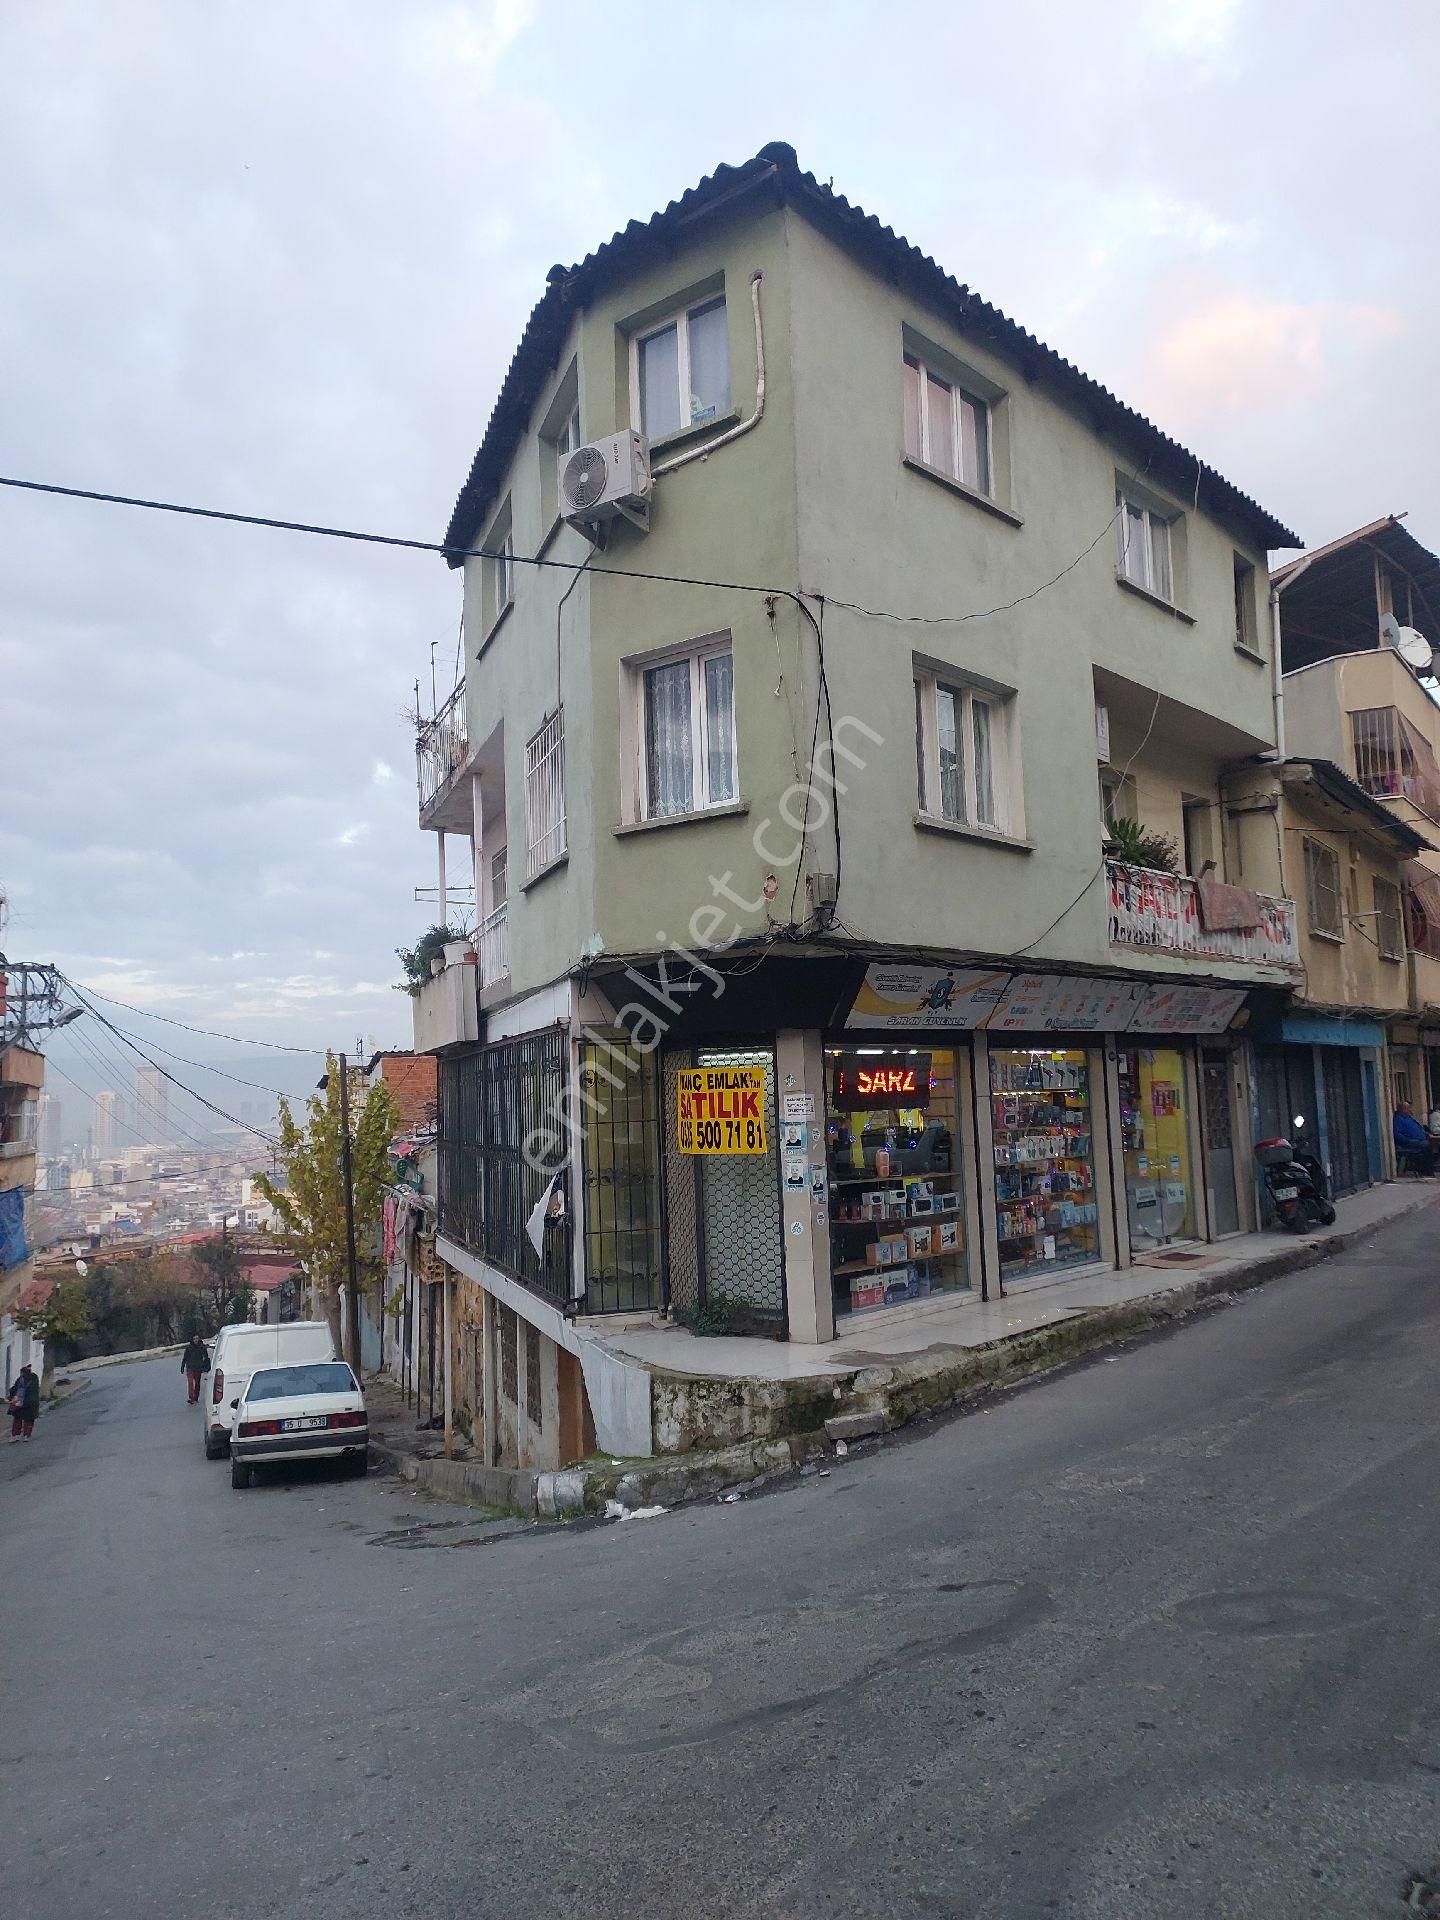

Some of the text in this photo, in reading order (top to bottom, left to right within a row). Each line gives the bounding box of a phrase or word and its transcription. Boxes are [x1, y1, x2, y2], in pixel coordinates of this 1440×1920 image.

[680, 1091, 760, 1120] SATILIK
[697, 1120, 722, 1149] 500
[725, 1120, 741, 1149] 71
[747, 1120, 763, 1149] 81
